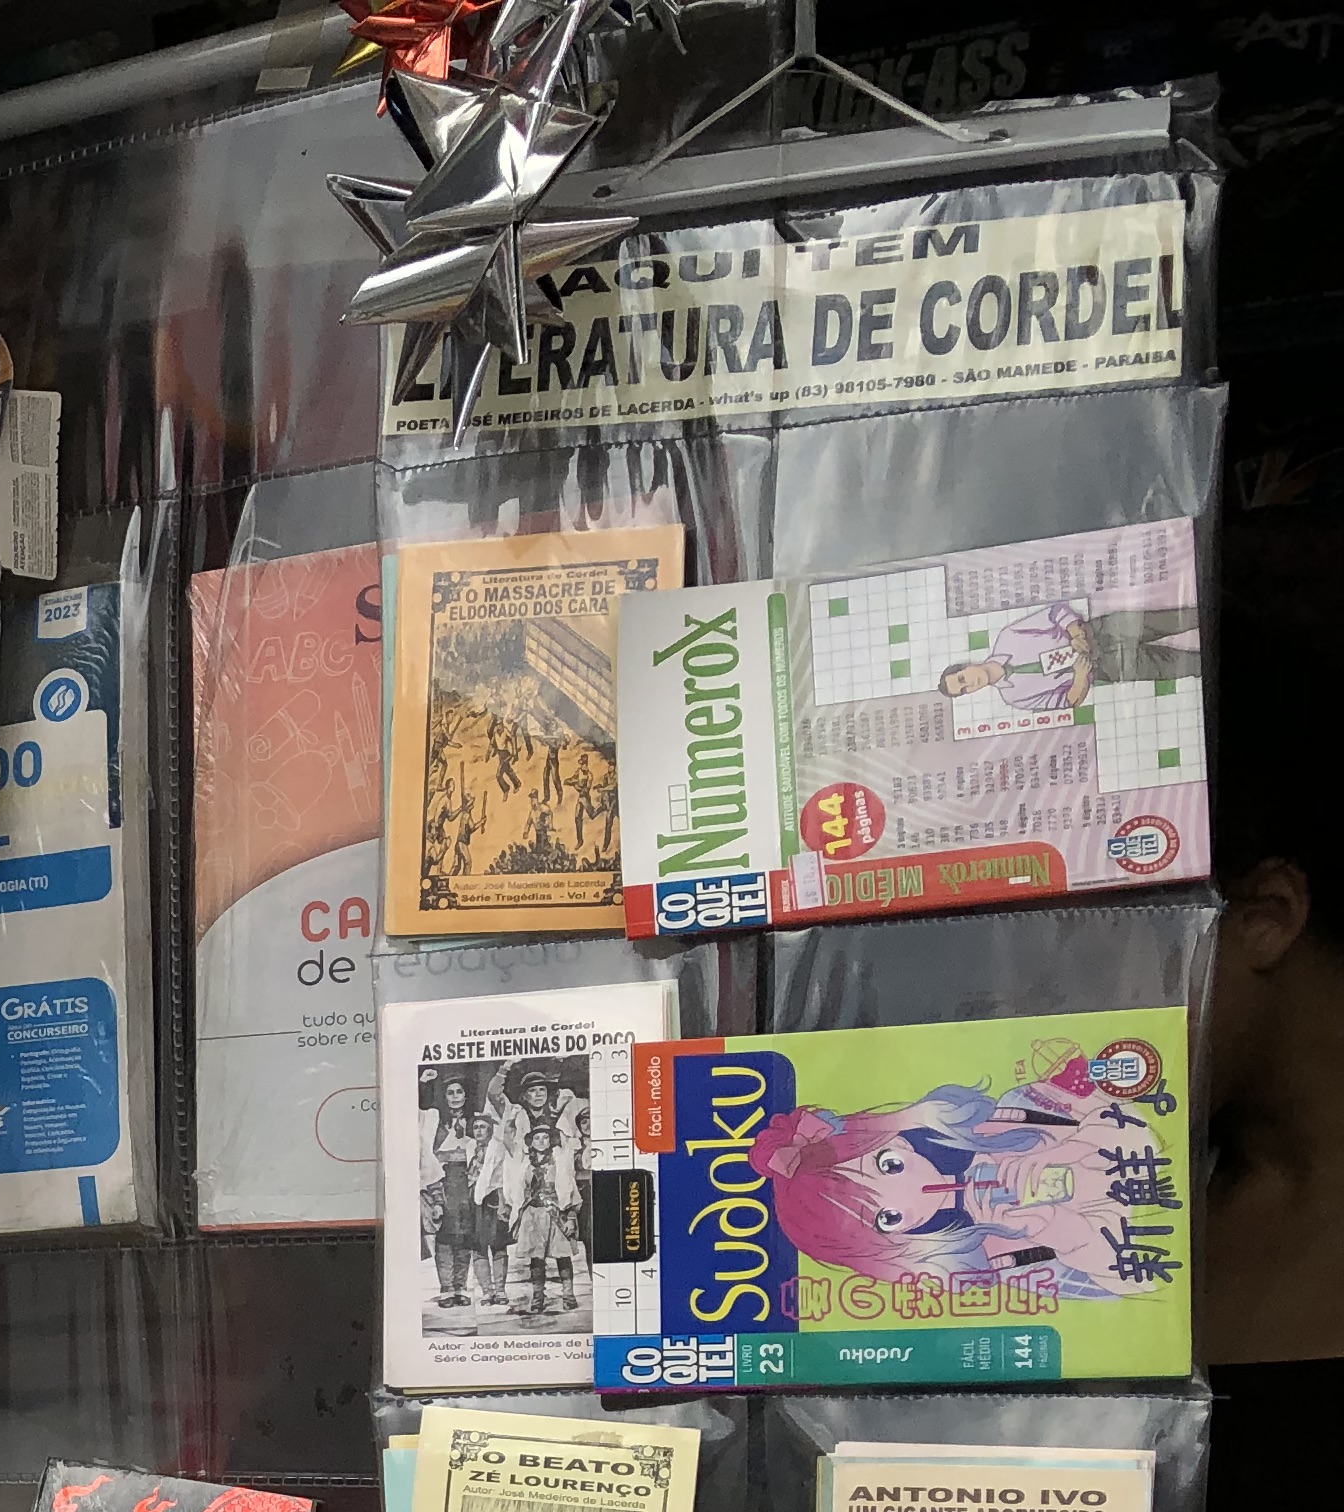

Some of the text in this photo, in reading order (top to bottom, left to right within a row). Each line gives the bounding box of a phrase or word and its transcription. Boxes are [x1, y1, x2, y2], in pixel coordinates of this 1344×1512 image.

[560, 224, 981, 297] AQUI TEM
[811, 254, 1183, 367] DE CORDEL
[396, 418, 450, 433] POETA
[498, 406, 584, 426] MEDEIROS
[589, 405, 612, 419] DE
[617, 397, 695, 416] LACERDA
[795, 383, 828, 399] (83)
[953, 366, 990, 384] SÃO
[997, 359, 1076, 380] MAMEDE
[465, 580, 615, 604] O MASSACRE DE
[45, 601, 83, 624] 2023
[449, 600, 563, 621] ELDORADO DOS
[818, 793, 851, 856] 144
[853, 790, 875, 844] páginas
[29, 875, 48, 892] (TI)
[0, 995, 89, 1021] GRÁTIS
[7, 1023, 88, 1041] CONCURSEIRO
[422, 1036, 587, 1061] AS SETE MENINAS DO
[684, 1065, 770, 1322] Sudoku
[626, 1181, 641, 1252] Clássicos
[483, 1452, 635, 1476] O BEATO
[468, 1469, 651, 1499] ZÉ LOURENÇO
[848, 1485, 1107, 1507] ANTONIO IVO
